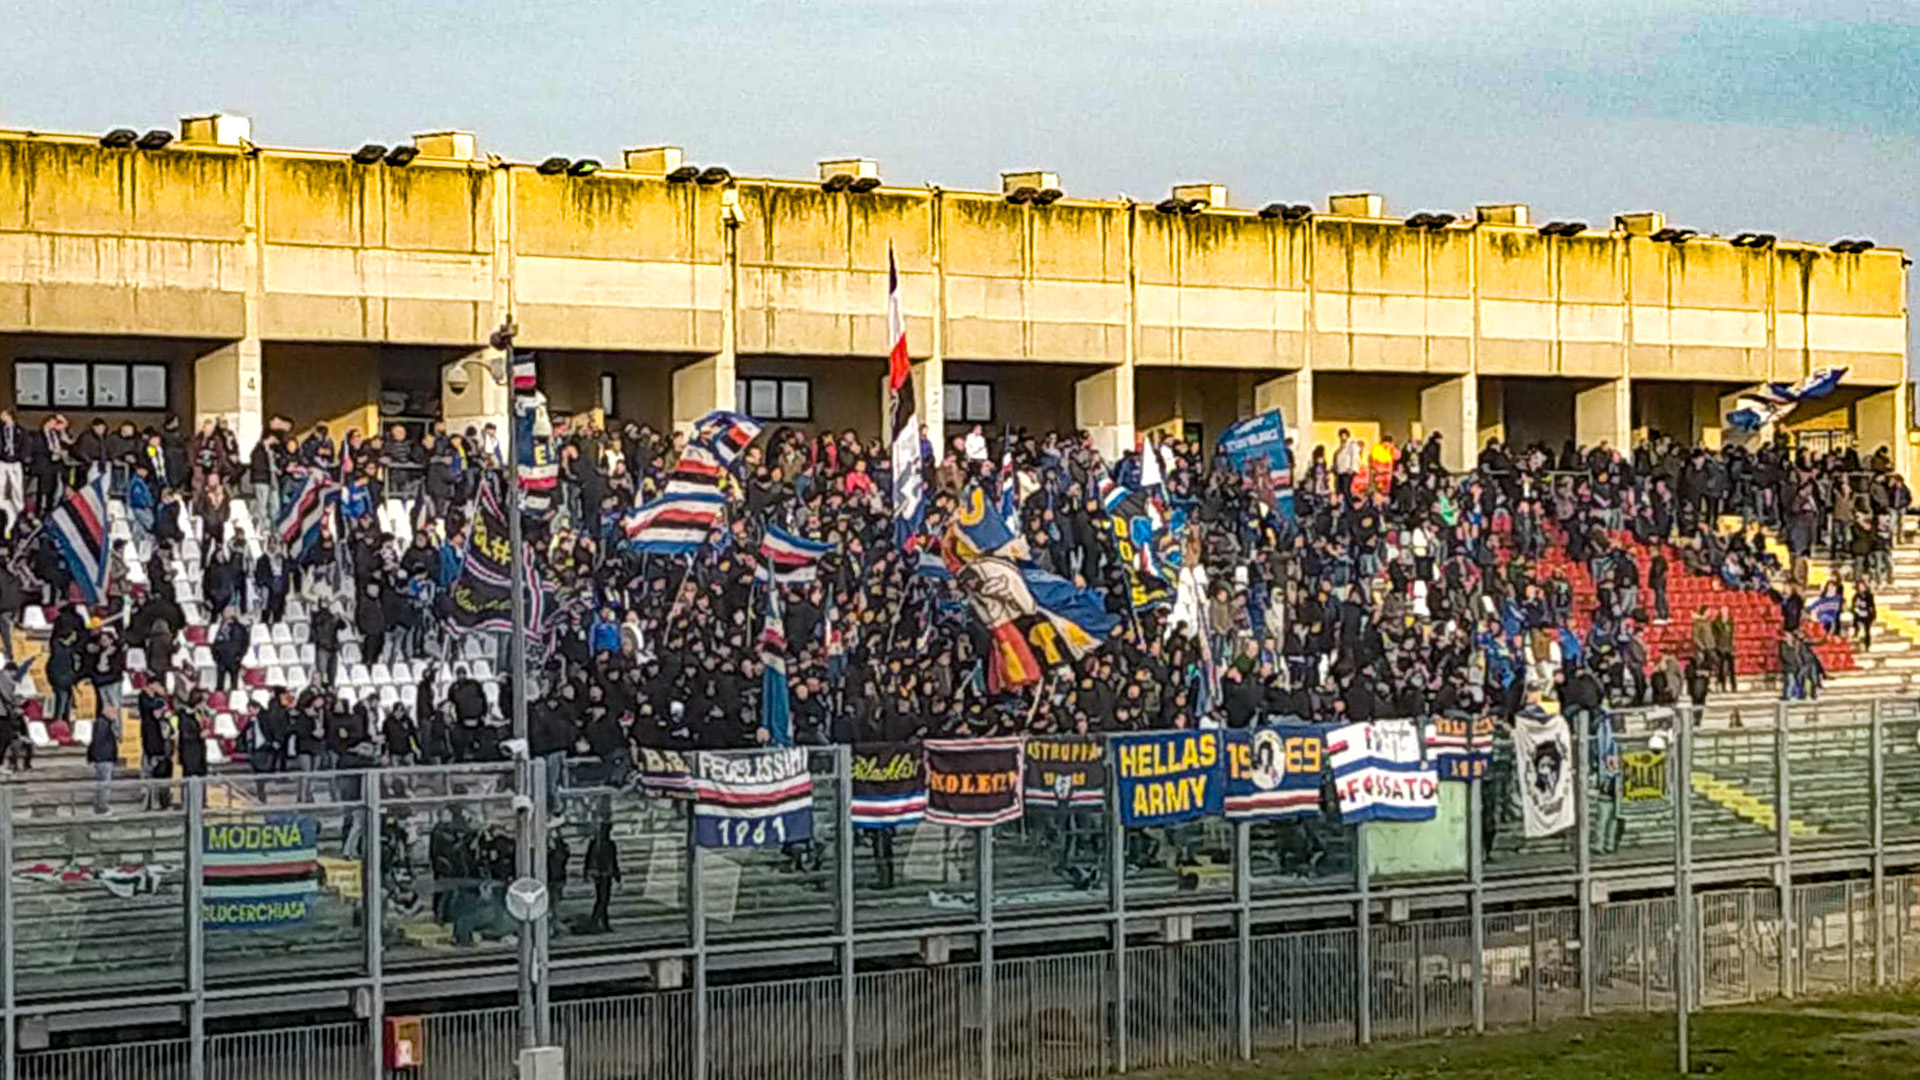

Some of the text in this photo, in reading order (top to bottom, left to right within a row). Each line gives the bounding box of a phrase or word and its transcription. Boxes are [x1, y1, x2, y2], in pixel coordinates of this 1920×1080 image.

[1118, 733, 1217, 777] HELLAS
[1132, 774, 1208, 817] ARMY
[1346, 774, 1435, 803] FOSSATO
[208, 823, 302, 851] MODENA
